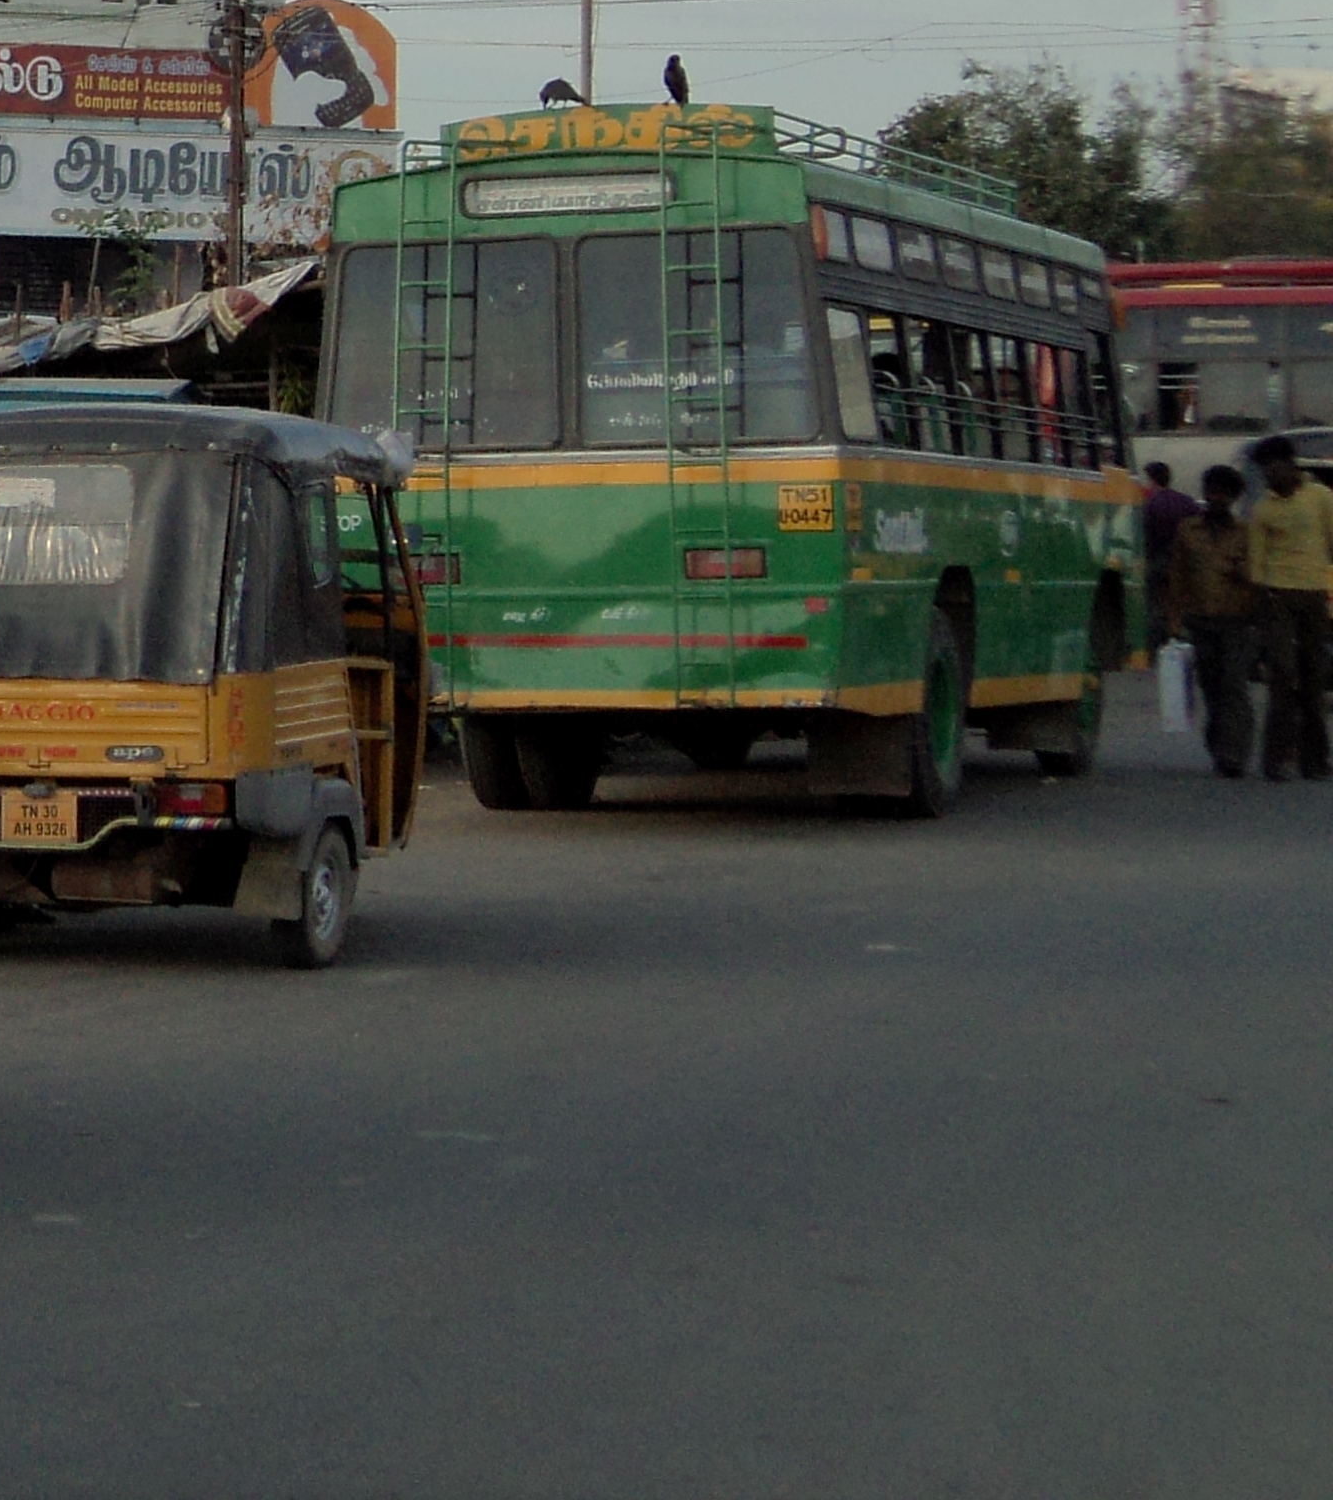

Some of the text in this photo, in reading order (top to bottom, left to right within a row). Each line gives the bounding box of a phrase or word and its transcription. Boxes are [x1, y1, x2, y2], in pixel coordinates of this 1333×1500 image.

[75, 75, 223, 96] All Model Accessories
[74, 93, 223, 114] Computer Accessories
[458, 104, 754, 160] செந்தில்
[21, 805, 59, 819] TN 30
[14, 822, 67, 837] AH 9326
